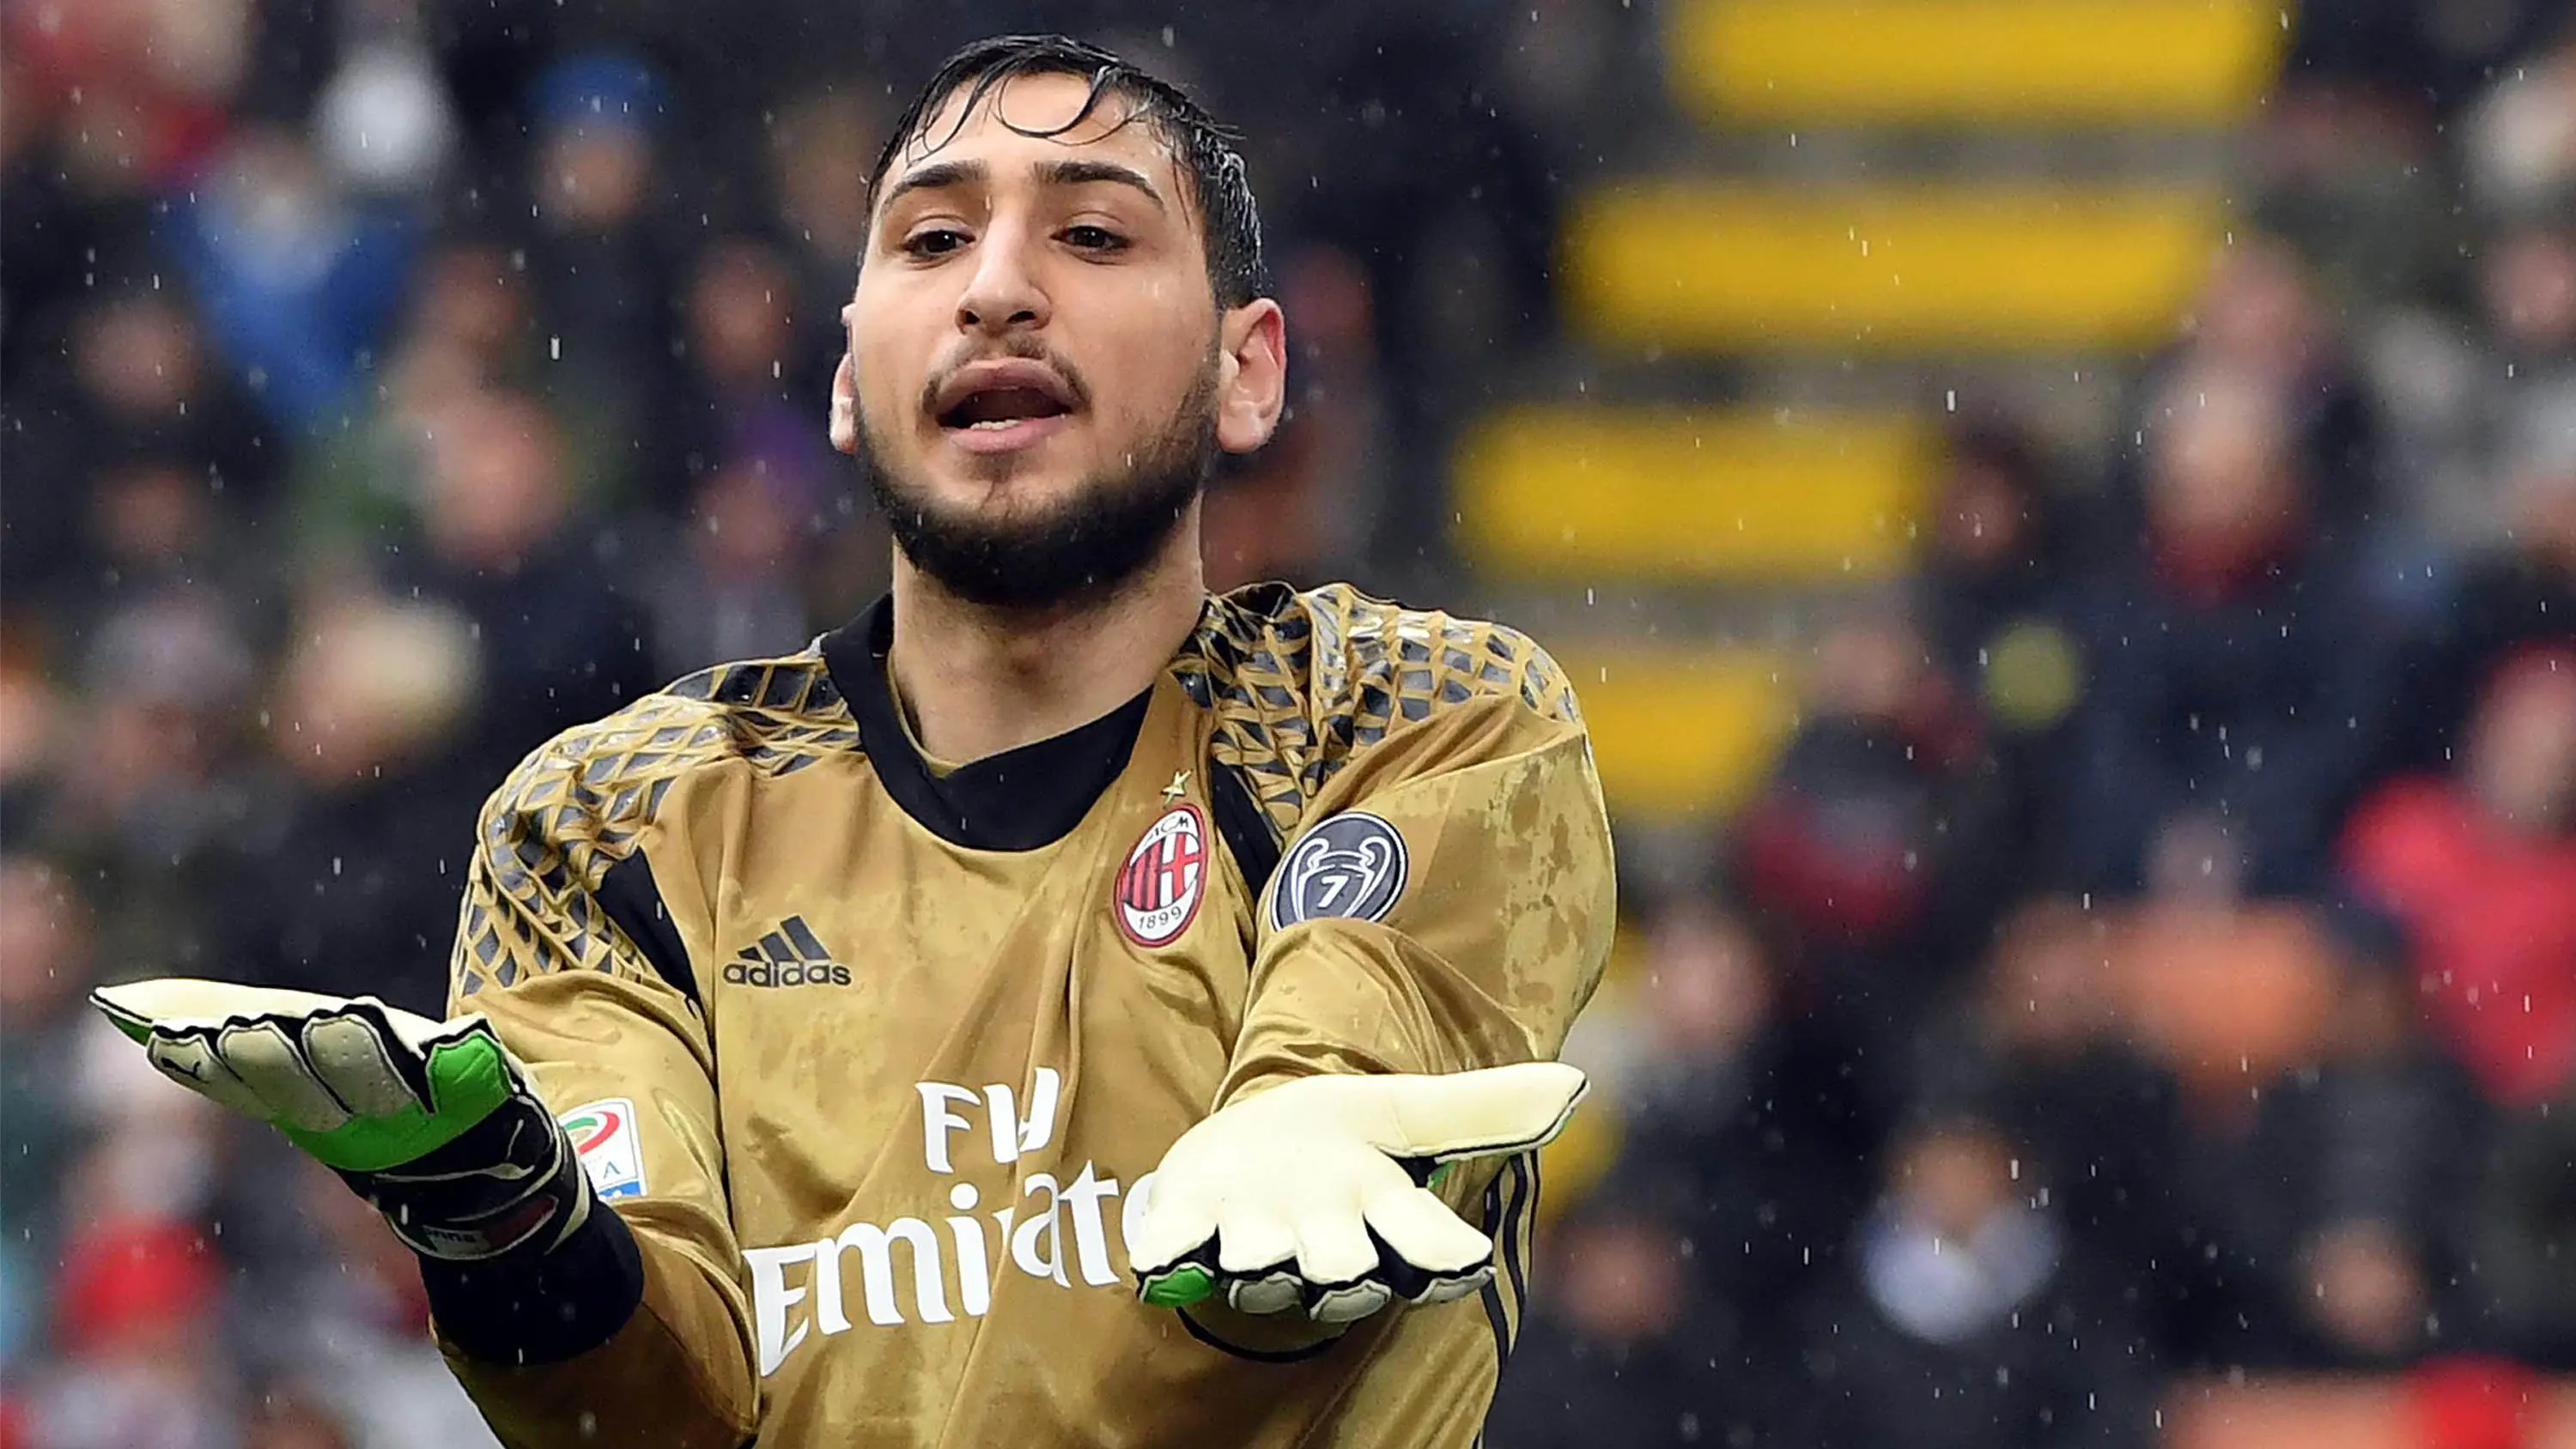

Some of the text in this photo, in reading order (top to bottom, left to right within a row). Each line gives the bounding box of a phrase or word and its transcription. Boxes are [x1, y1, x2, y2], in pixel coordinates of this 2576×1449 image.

[1317, 875, 1350, 909] 7
[1138, 906, 1182, 930] 1899
[722, 961, 852, 988] adidas
